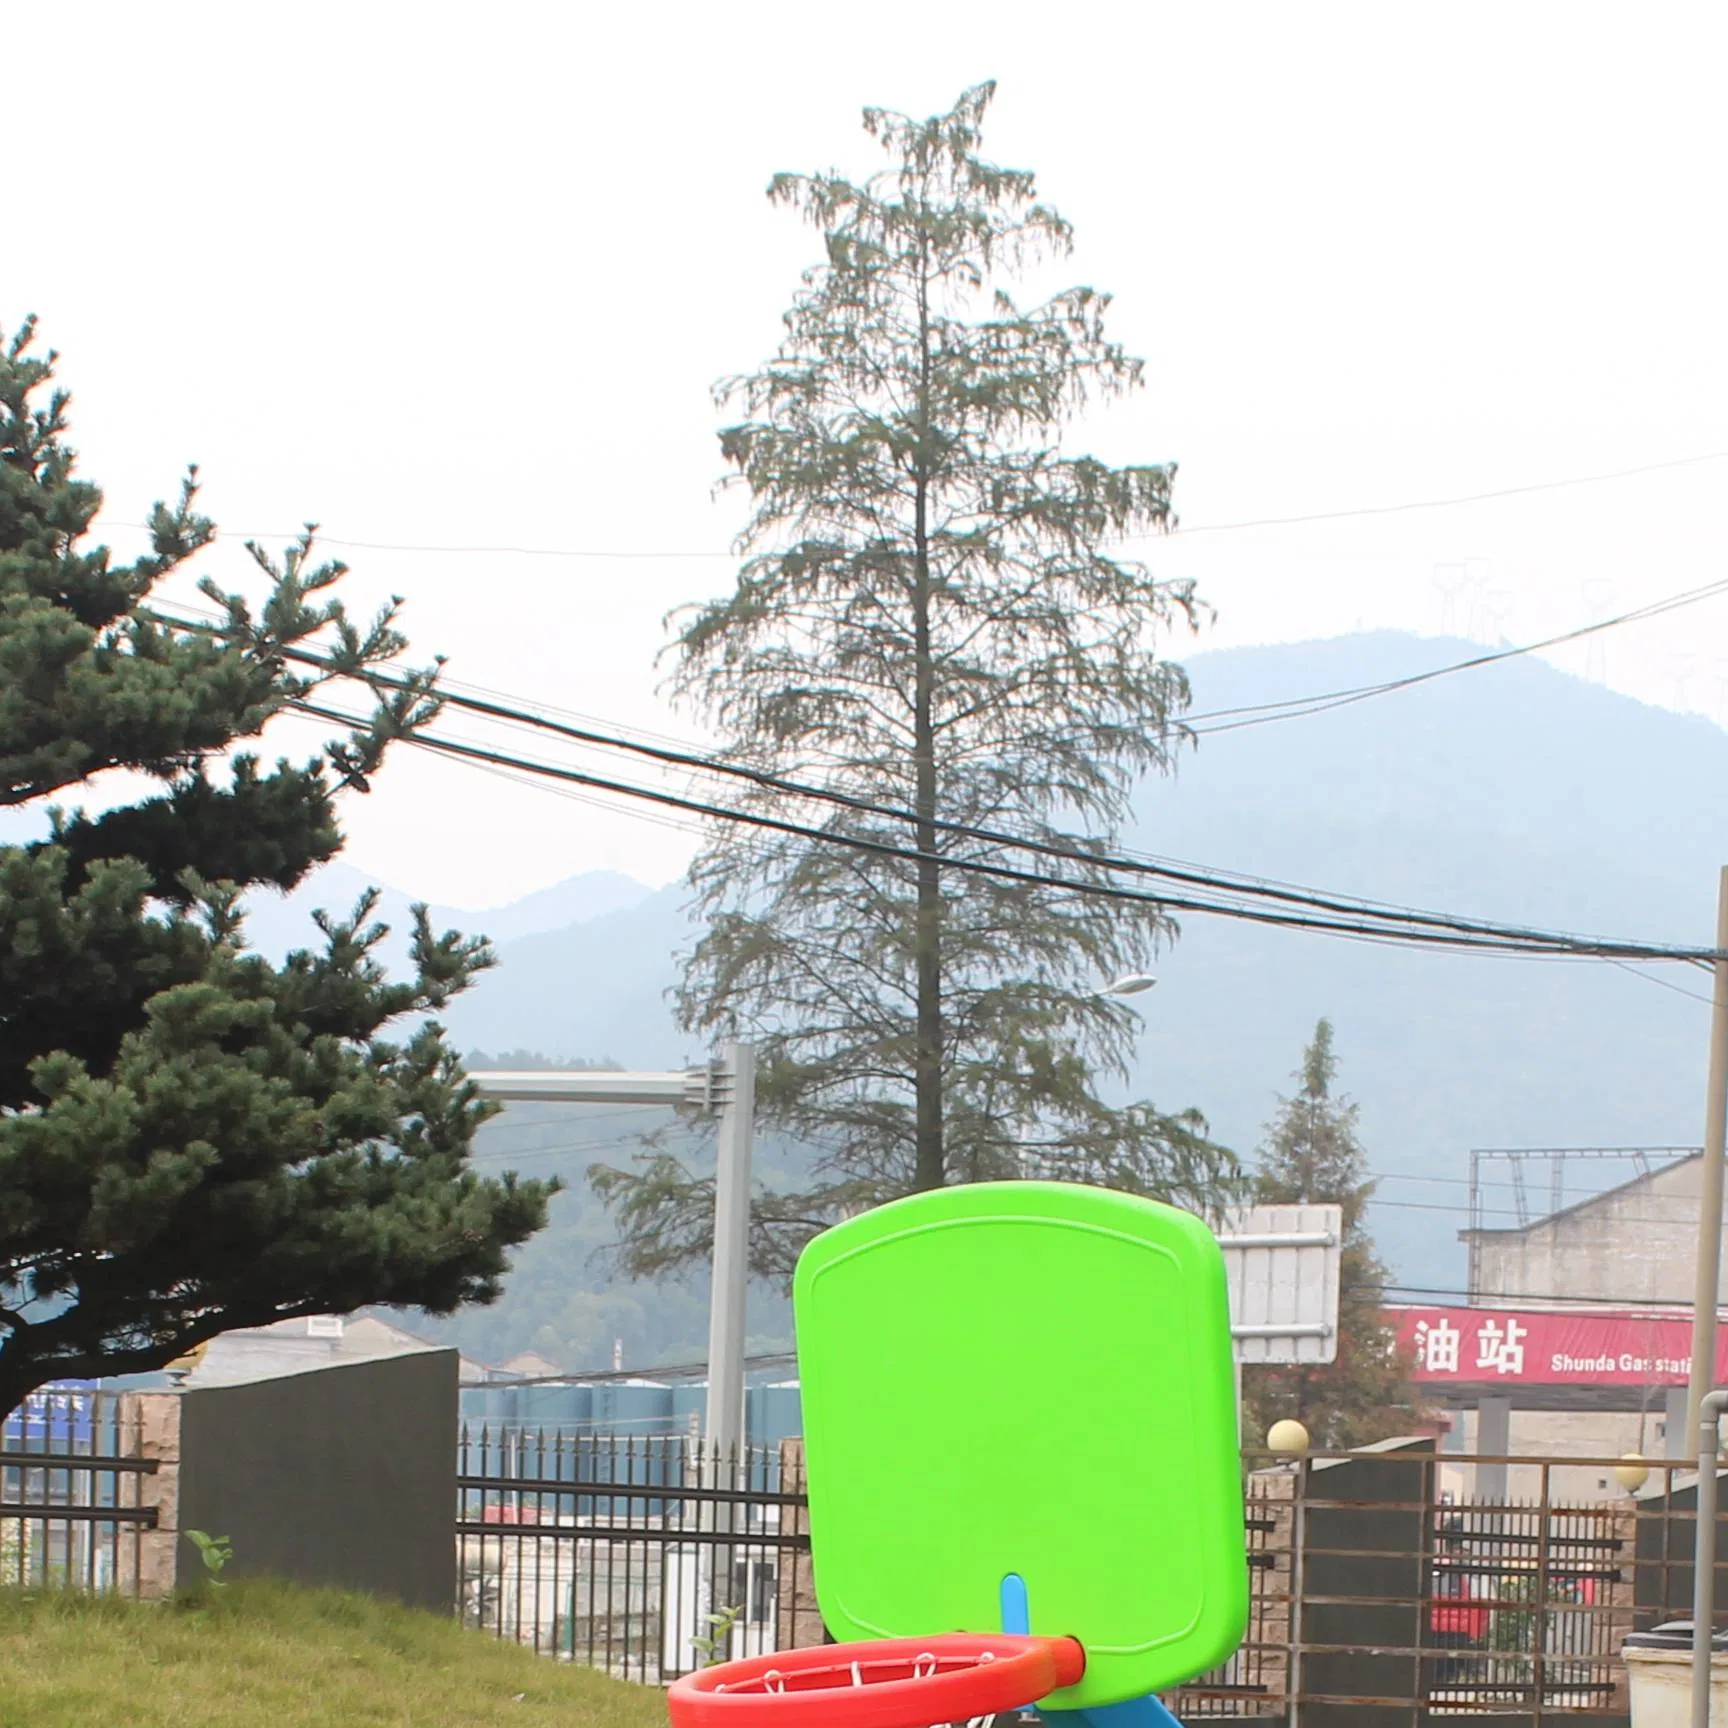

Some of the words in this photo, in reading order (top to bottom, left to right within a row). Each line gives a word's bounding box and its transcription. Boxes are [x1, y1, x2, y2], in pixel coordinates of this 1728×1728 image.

[1364, 1318, 1528, 1375] 油站
[1551, 1353, 1616, 1372] Shunda
[1655, 1356, 1693, 1375] stati
